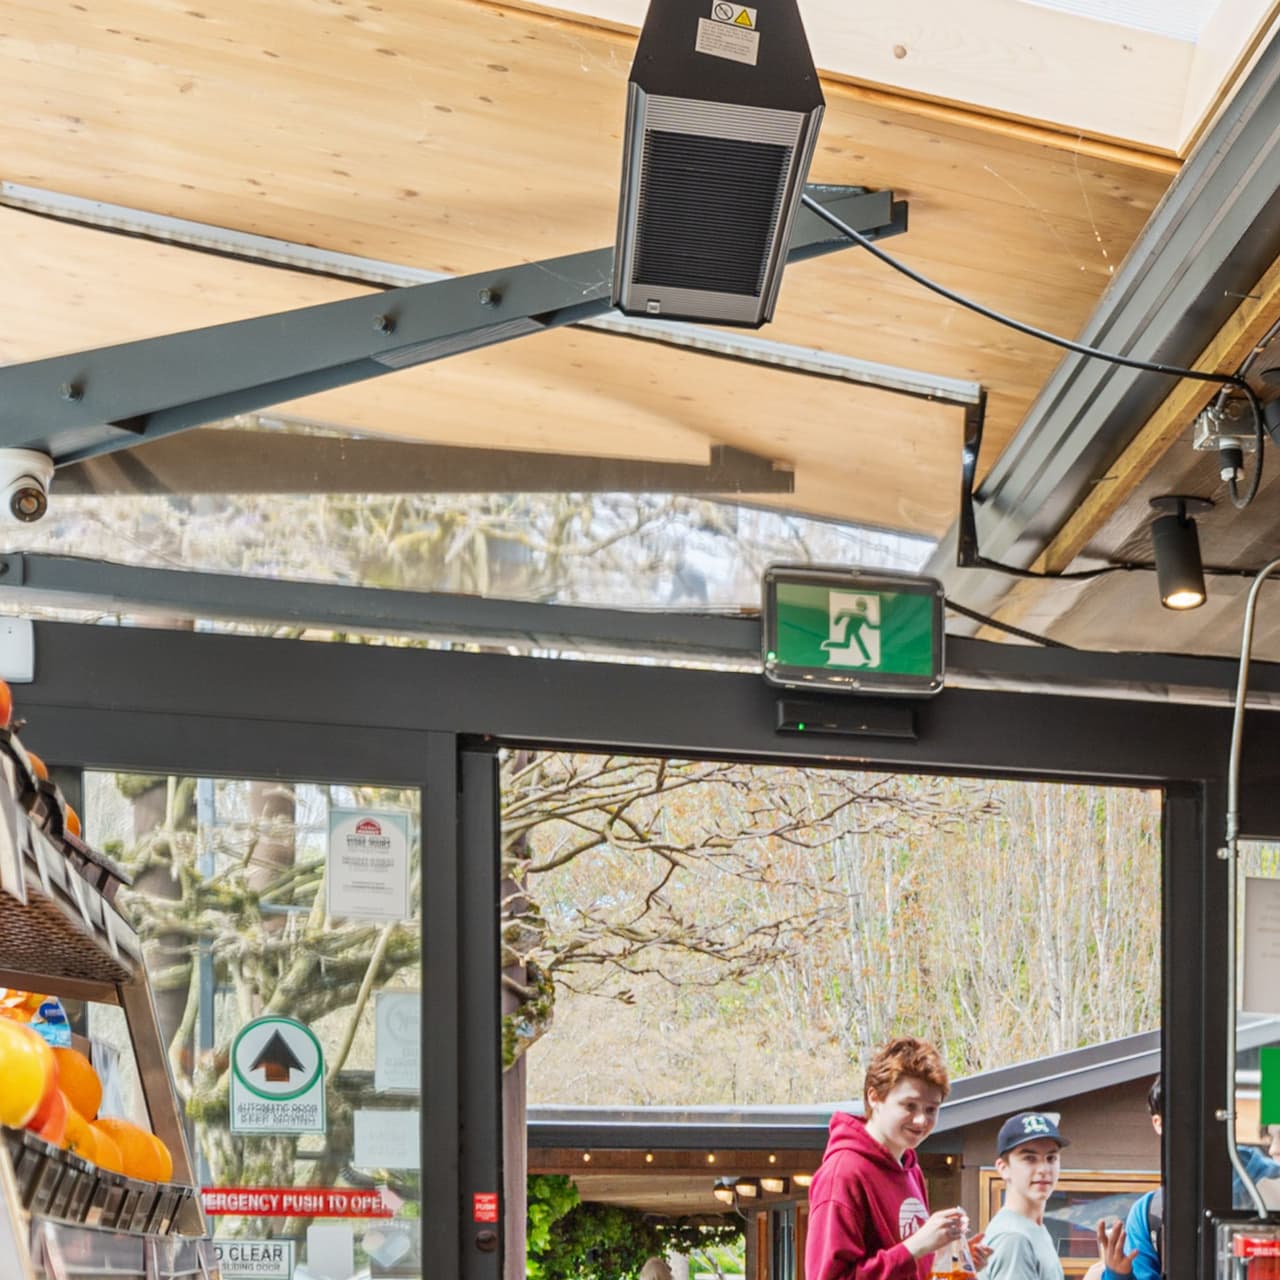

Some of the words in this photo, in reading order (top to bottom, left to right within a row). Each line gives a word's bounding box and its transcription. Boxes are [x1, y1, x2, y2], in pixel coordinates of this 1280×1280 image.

[200, 1192, 281, 1213] MERGENCY
[282, 1194, 324, 1213] PUSH
[326, 1195, 348, 1213] TO
[228, 1246, 283, 1262] CLEAR
[255, 1263, 281, 1272] DOOR
